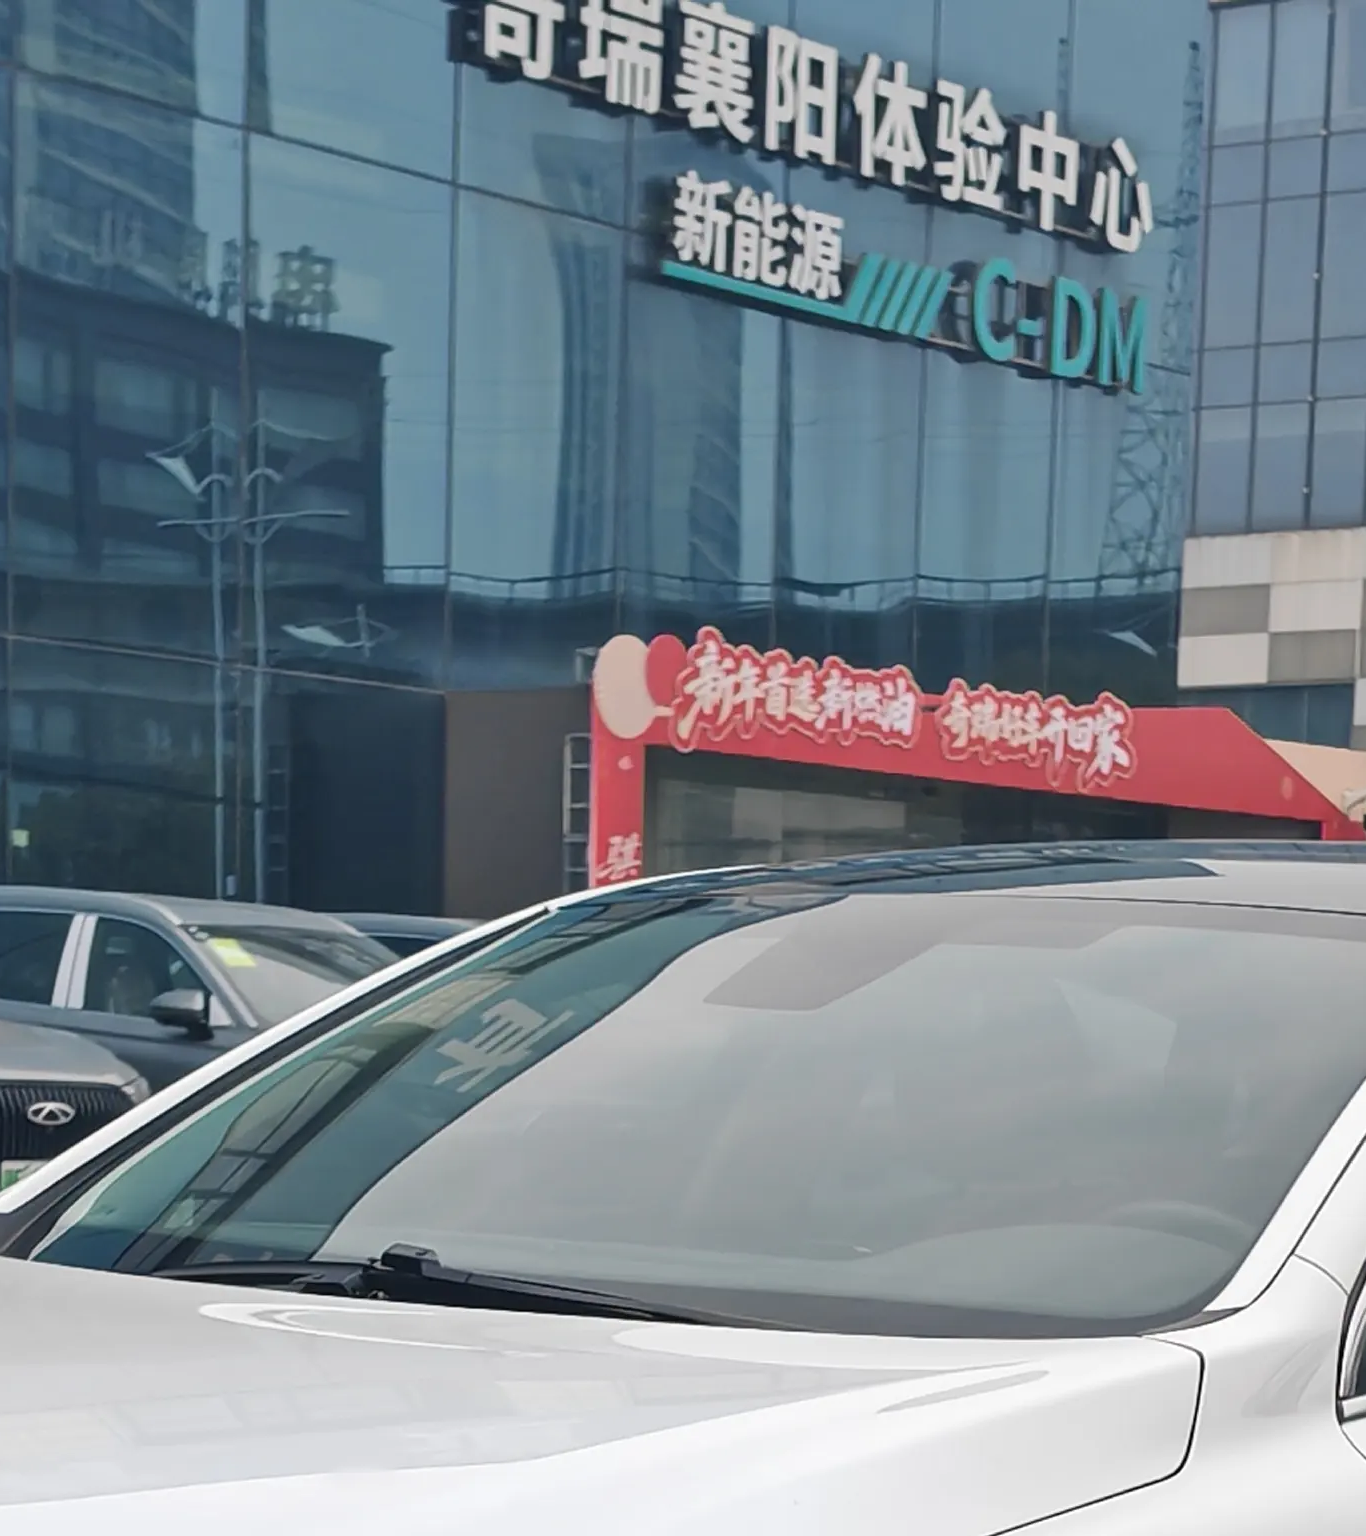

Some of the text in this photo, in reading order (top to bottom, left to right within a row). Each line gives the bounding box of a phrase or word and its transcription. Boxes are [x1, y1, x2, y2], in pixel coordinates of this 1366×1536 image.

[671, 170, 846, 300] 新能源
[972, 257, 1147, 394] C-DM
